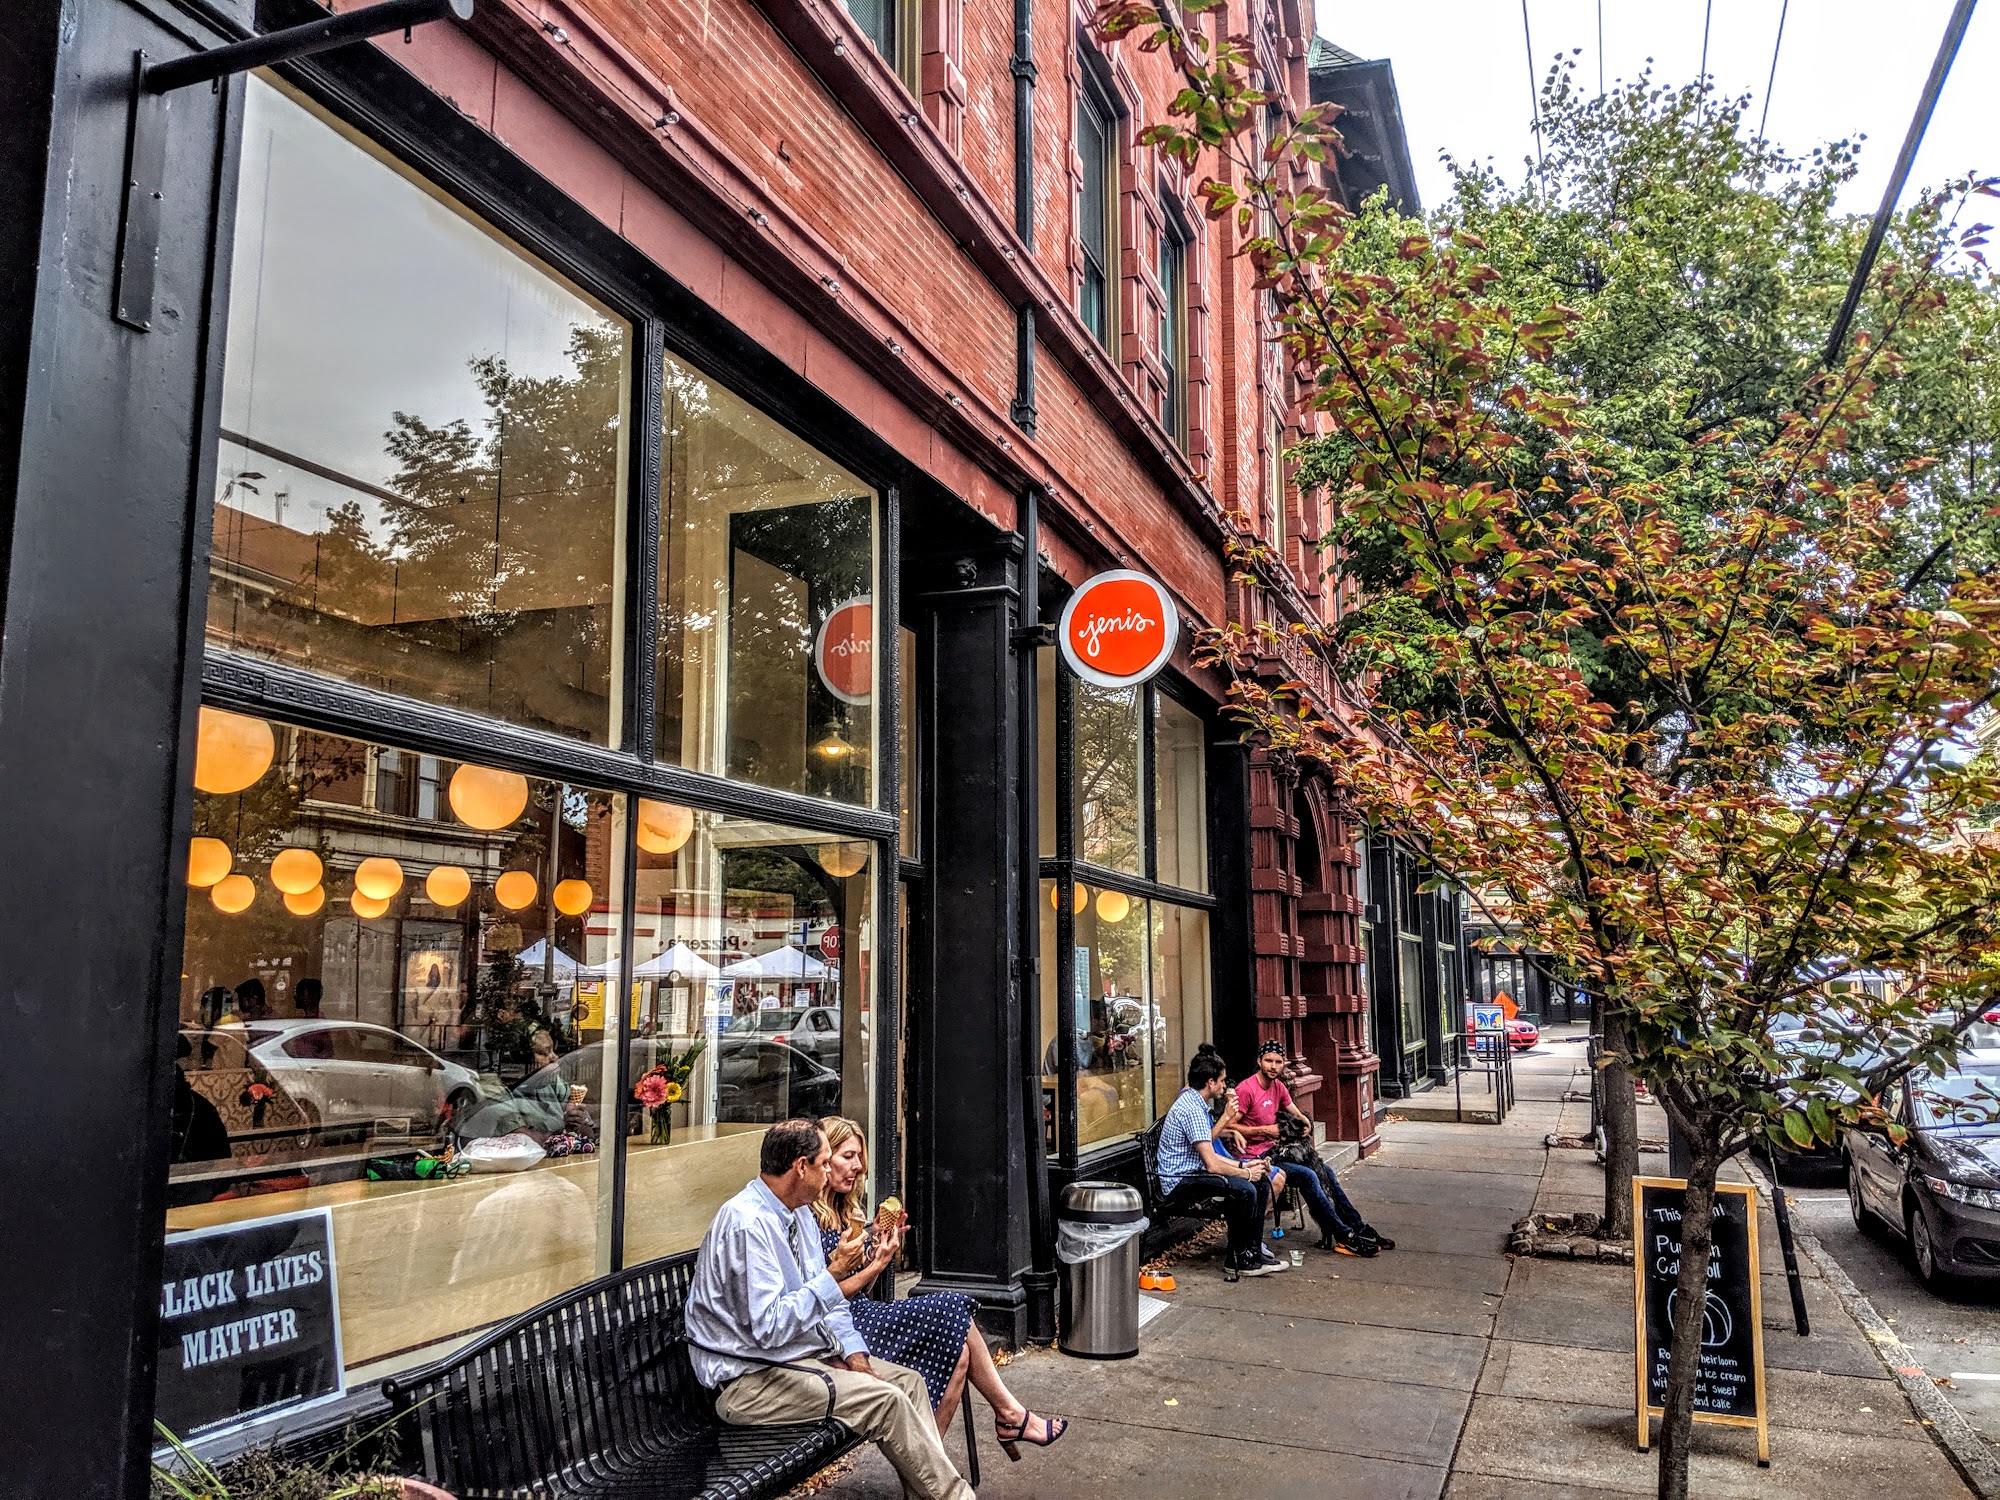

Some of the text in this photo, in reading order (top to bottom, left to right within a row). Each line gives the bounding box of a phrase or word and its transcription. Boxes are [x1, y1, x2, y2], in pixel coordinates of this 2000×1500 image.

[1653, 1208, 1681, 1222] This
[160, 1250, 324, 1318] LACK LIVES
[181, 1308, 299, 1370] MATTER
[1700, 1353, 1738, 1366] heirloom
[1705, 1368, 1717, 1379] ice
[1720, 1372, 1746, 1383] cream
[1712, 1385, 1738, 1396] sweet
[1711, 1399, 1731, 1409] cake
